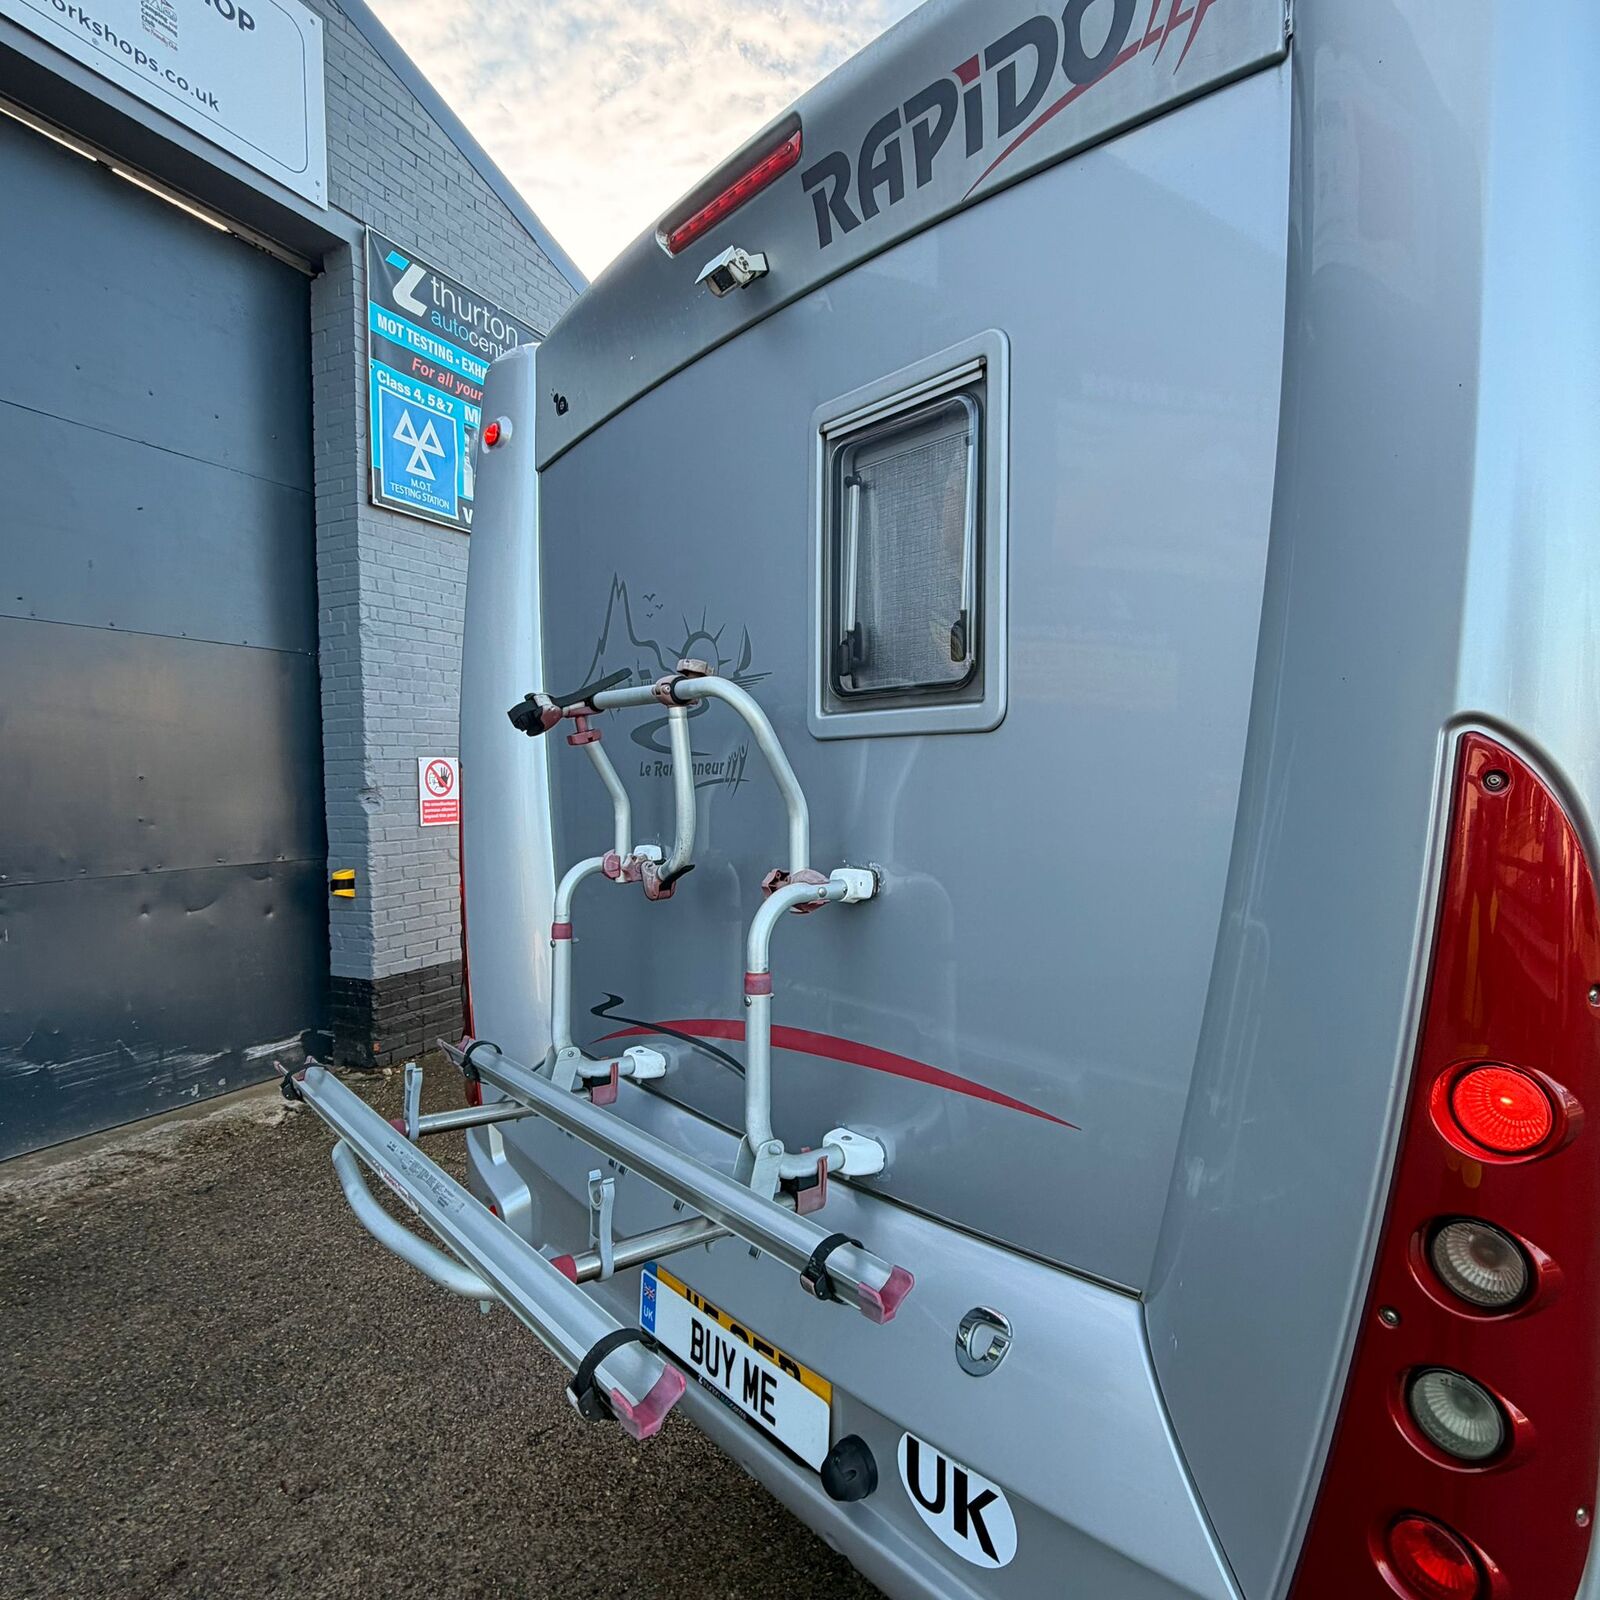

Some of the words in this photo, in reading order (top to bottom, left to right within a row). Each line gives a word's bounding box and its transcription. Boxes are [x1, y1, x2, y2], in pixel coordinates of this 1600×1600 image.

[205, 0, 255, 31] OP
[44, 0, 220, 112] orkshops.co.uk
[430, 276, 518, 347] thurton
[431, 310, 506, 358] autocent
[377, 313, 404, 338] MOT
[406, 327, 453, 364] TESTING
[377, 370, 411, 397] Class
[413, 388, 425, 404] 4,
[411, 357, 435, 379] For
[437, 372, 453, 388] all
[455, 380, 484, 400] your
[389, 481, 422, 501] TESTING
[422, 493, 450, 510] STATION
[640, 760, 651, 777] Le
[644, 1306, 654, 1322] UK
[690, 1317, 736, 1390] BUY
[743, 1356, 777, 1426] ME
[907, 1432, 1000, 1564] UK
